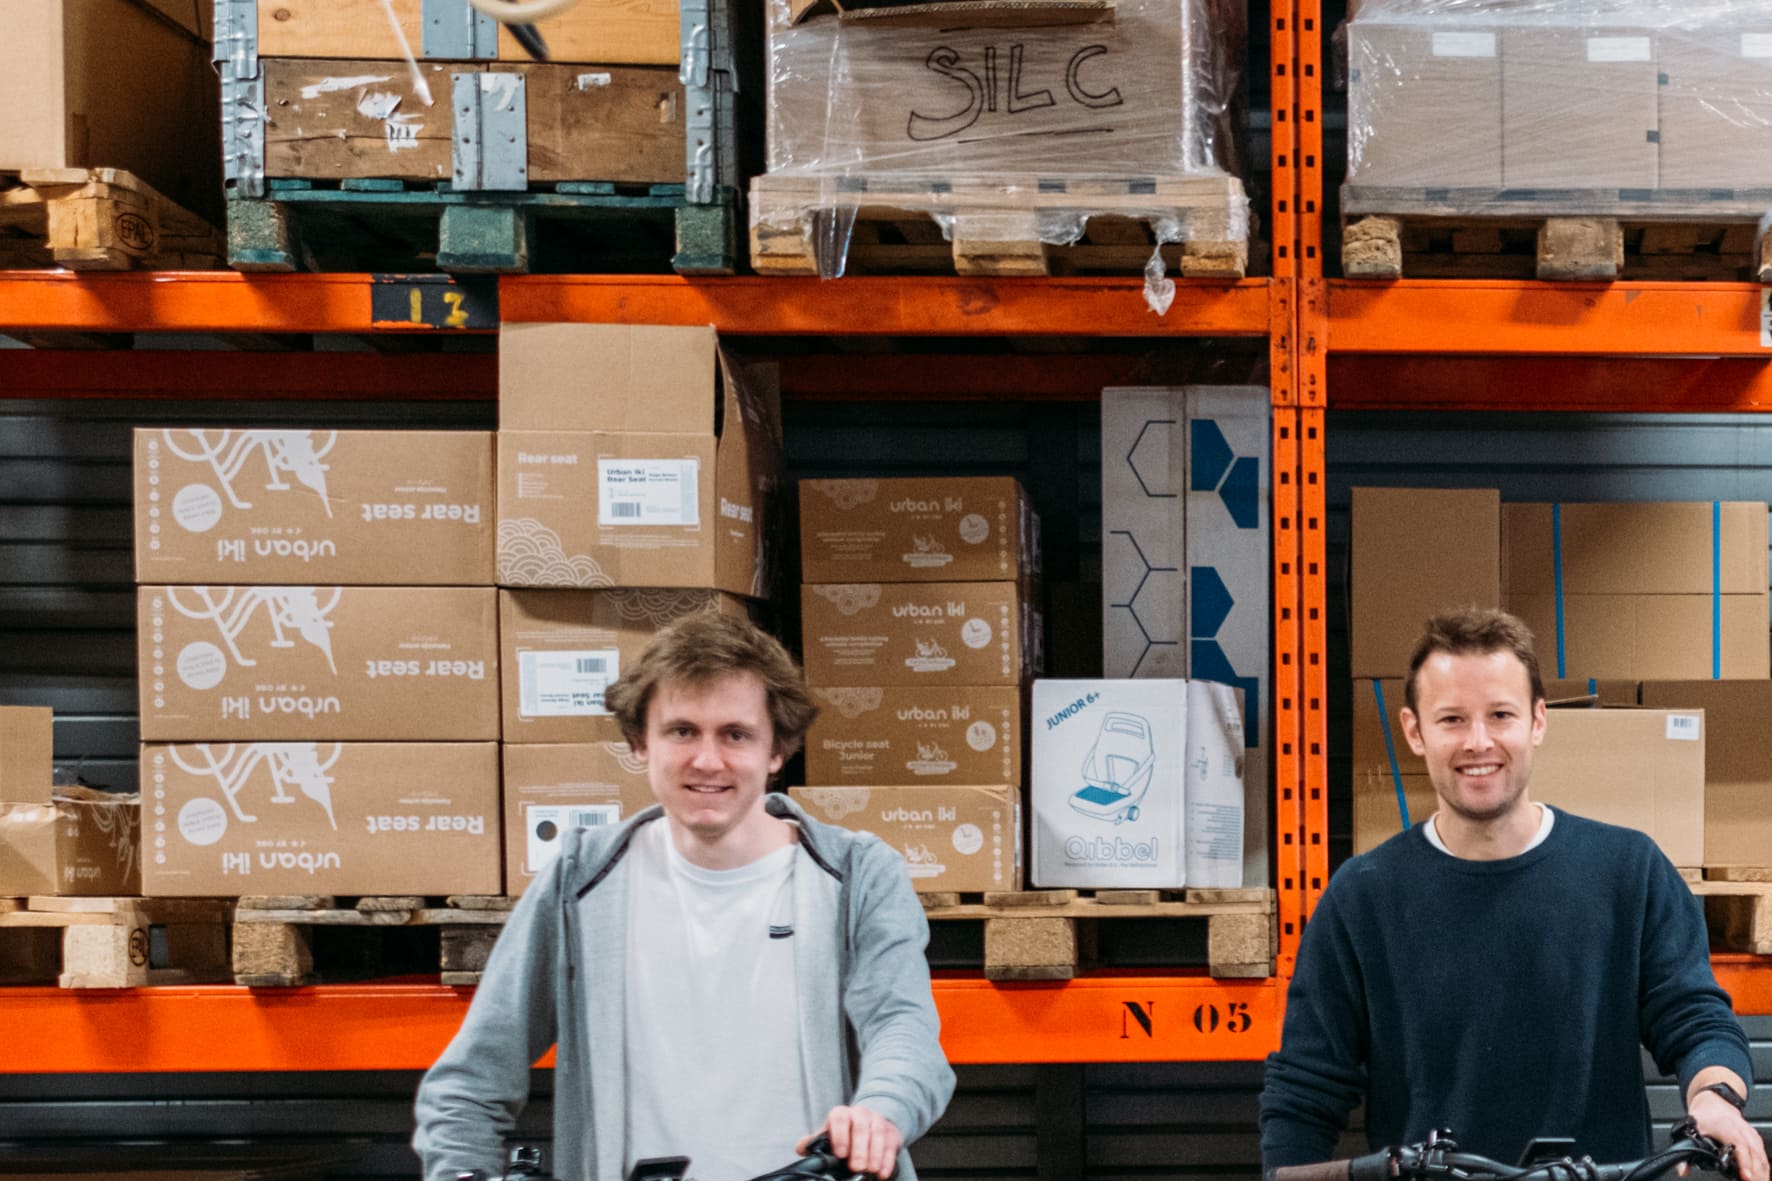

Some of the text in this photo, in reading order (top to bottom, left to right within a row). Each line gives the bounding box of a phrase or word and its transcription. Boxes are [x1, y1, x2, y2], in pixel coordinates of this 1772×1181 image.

[518, 453, 577, 465] Rear seat
[361, 503, 480, 524] Rear seat
[890, 498, 940, 513] urban
[217, 540, 336, 562] urban iki
[893, 602, 943, 618] urban
[366, 660, 484, 680] Rear seat
[221, 697, 340, 719] urban iki
[897, 706, 947, 720] urban
[1046, 690, 1101, 731] JUNIOR 6+
[823, 739, 890, 750] Bicycle seat
[839, 751, 874, 761] Junior
[881, 807, 932, 822] urban
[366, 815, 484, 835] Rear seat
[223, 852, 340, 874] urban iki
[1120, 1001, 1252, 1039] N 05
